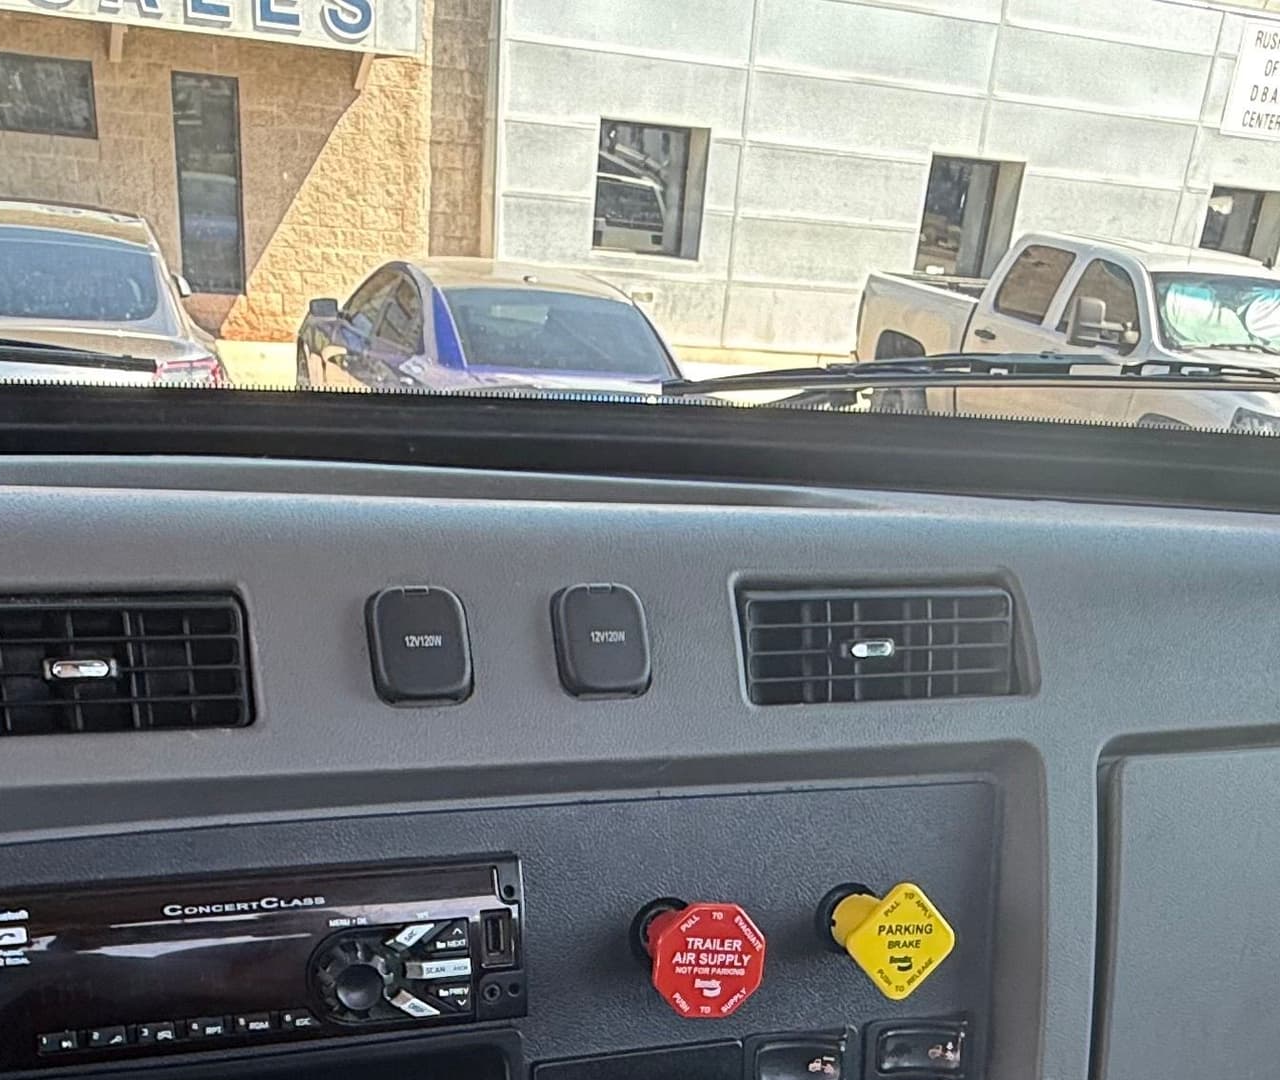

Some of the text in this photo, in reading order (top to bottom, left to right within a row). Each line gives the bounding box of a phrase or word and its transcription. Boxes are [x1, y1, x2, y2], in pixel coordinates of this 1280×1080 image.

[1264, 59, 1279, 77] OF
[404, 635, 442, 648] 12V120W
[590, 631, 626, 643] 12V120W
[883, 892, 934, 919] PULL TO APPLY
[680, 911, 763, 952] PULL TO EVACUATE
[877, 923, 933, 936] PARKING
[686, 937, 743, 952] TRAILER
[887, 939, 922, 950] BRAKE
[672, 951, 752, 967] AIR SUPPLY
[425, 966, 446, 974] SCAN
[675, 966, 746, 976] NOT FOR PARKING
[876, 957, 934, 993] PUSH TO RELEASE
[672, 987, 747, 1014] PUSH TO SUPPLY
